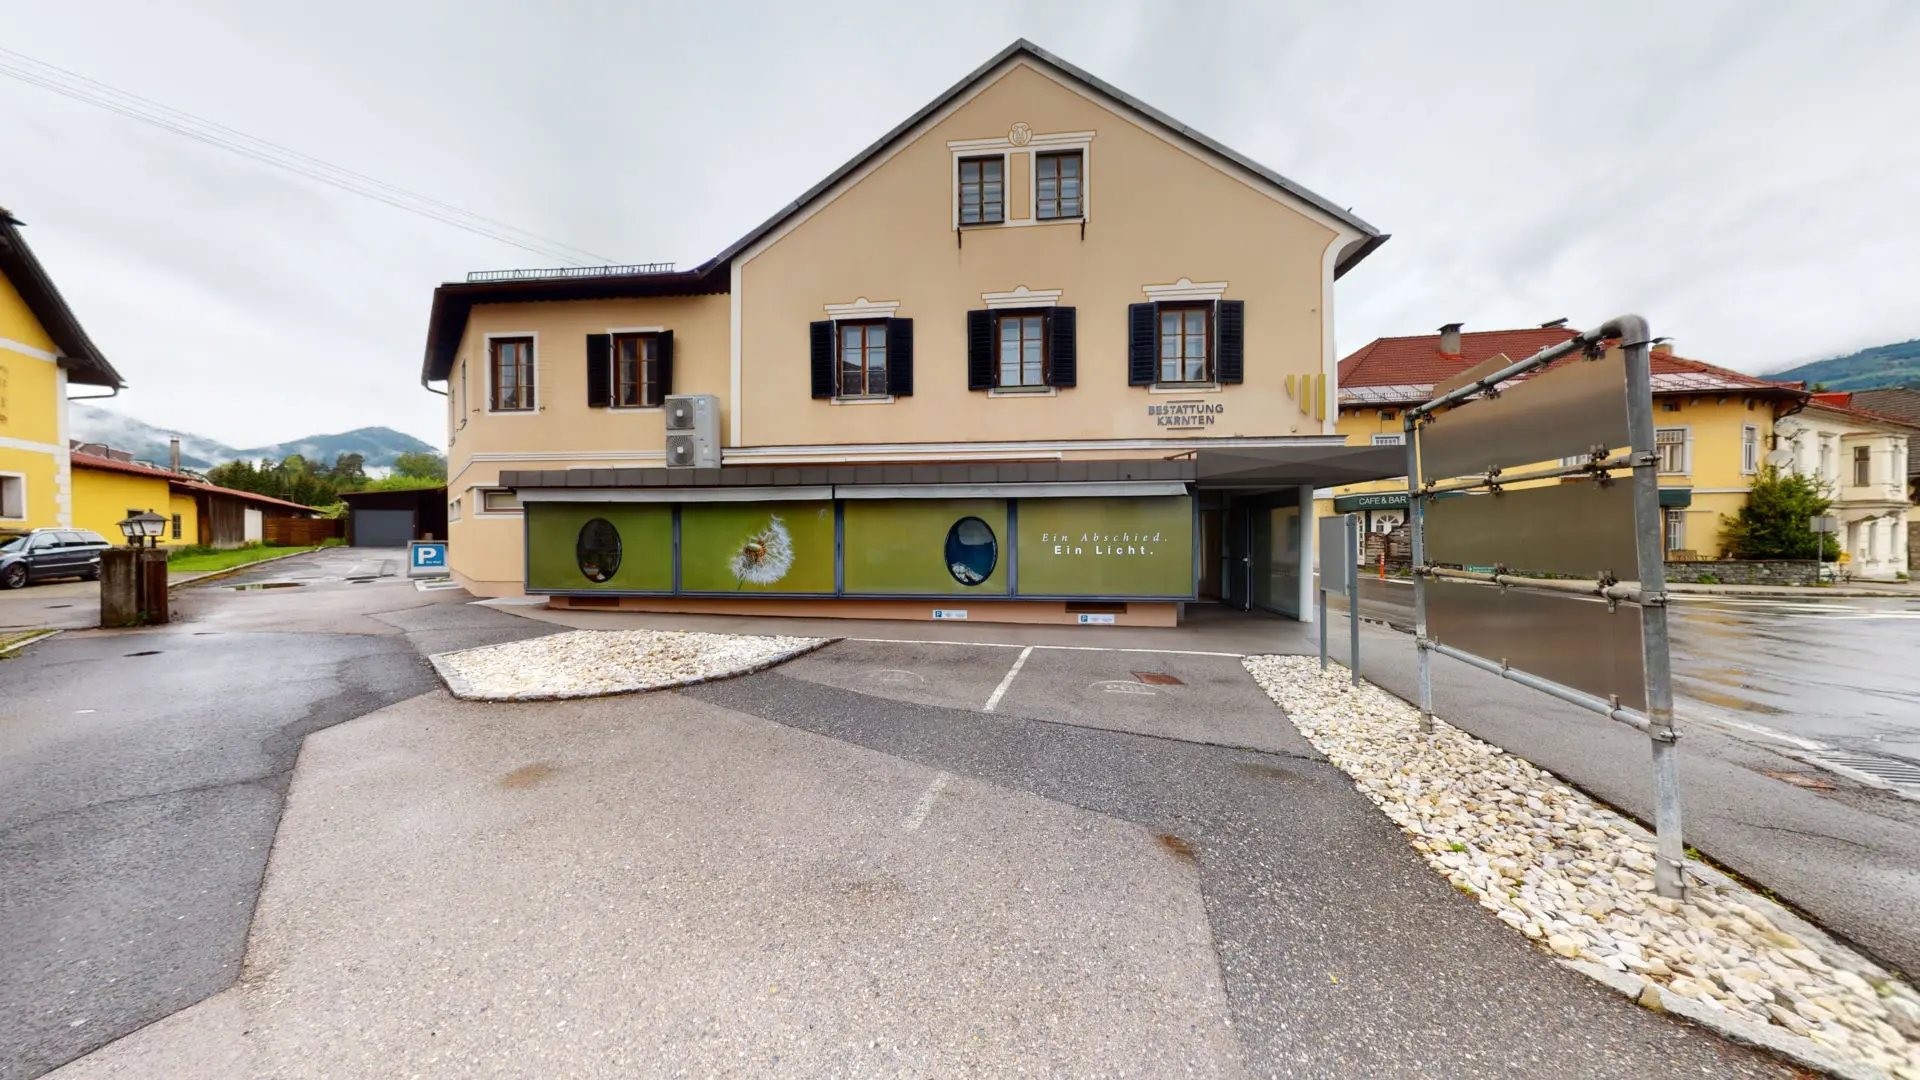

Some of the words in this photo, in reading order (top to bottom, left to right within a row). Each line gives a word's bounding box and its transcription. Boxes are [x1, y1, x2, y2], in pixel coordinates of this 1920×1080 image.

[1148, 404, 1223, 416] BESTATTUNG
[1157, 415, 1214, 426] KÄRNTEN
[1381, 496, 1387, 504] &
[1388, 496, 1407, 504] BAR
[1042, 533, 1068, 542] Ein
[1081, 532, 1168, 542] Abschied.
[1054, 545, 1082, 555] Ein
[1095, 545, 1154, 555] Licht.
[418, 548, 437, 564] P
